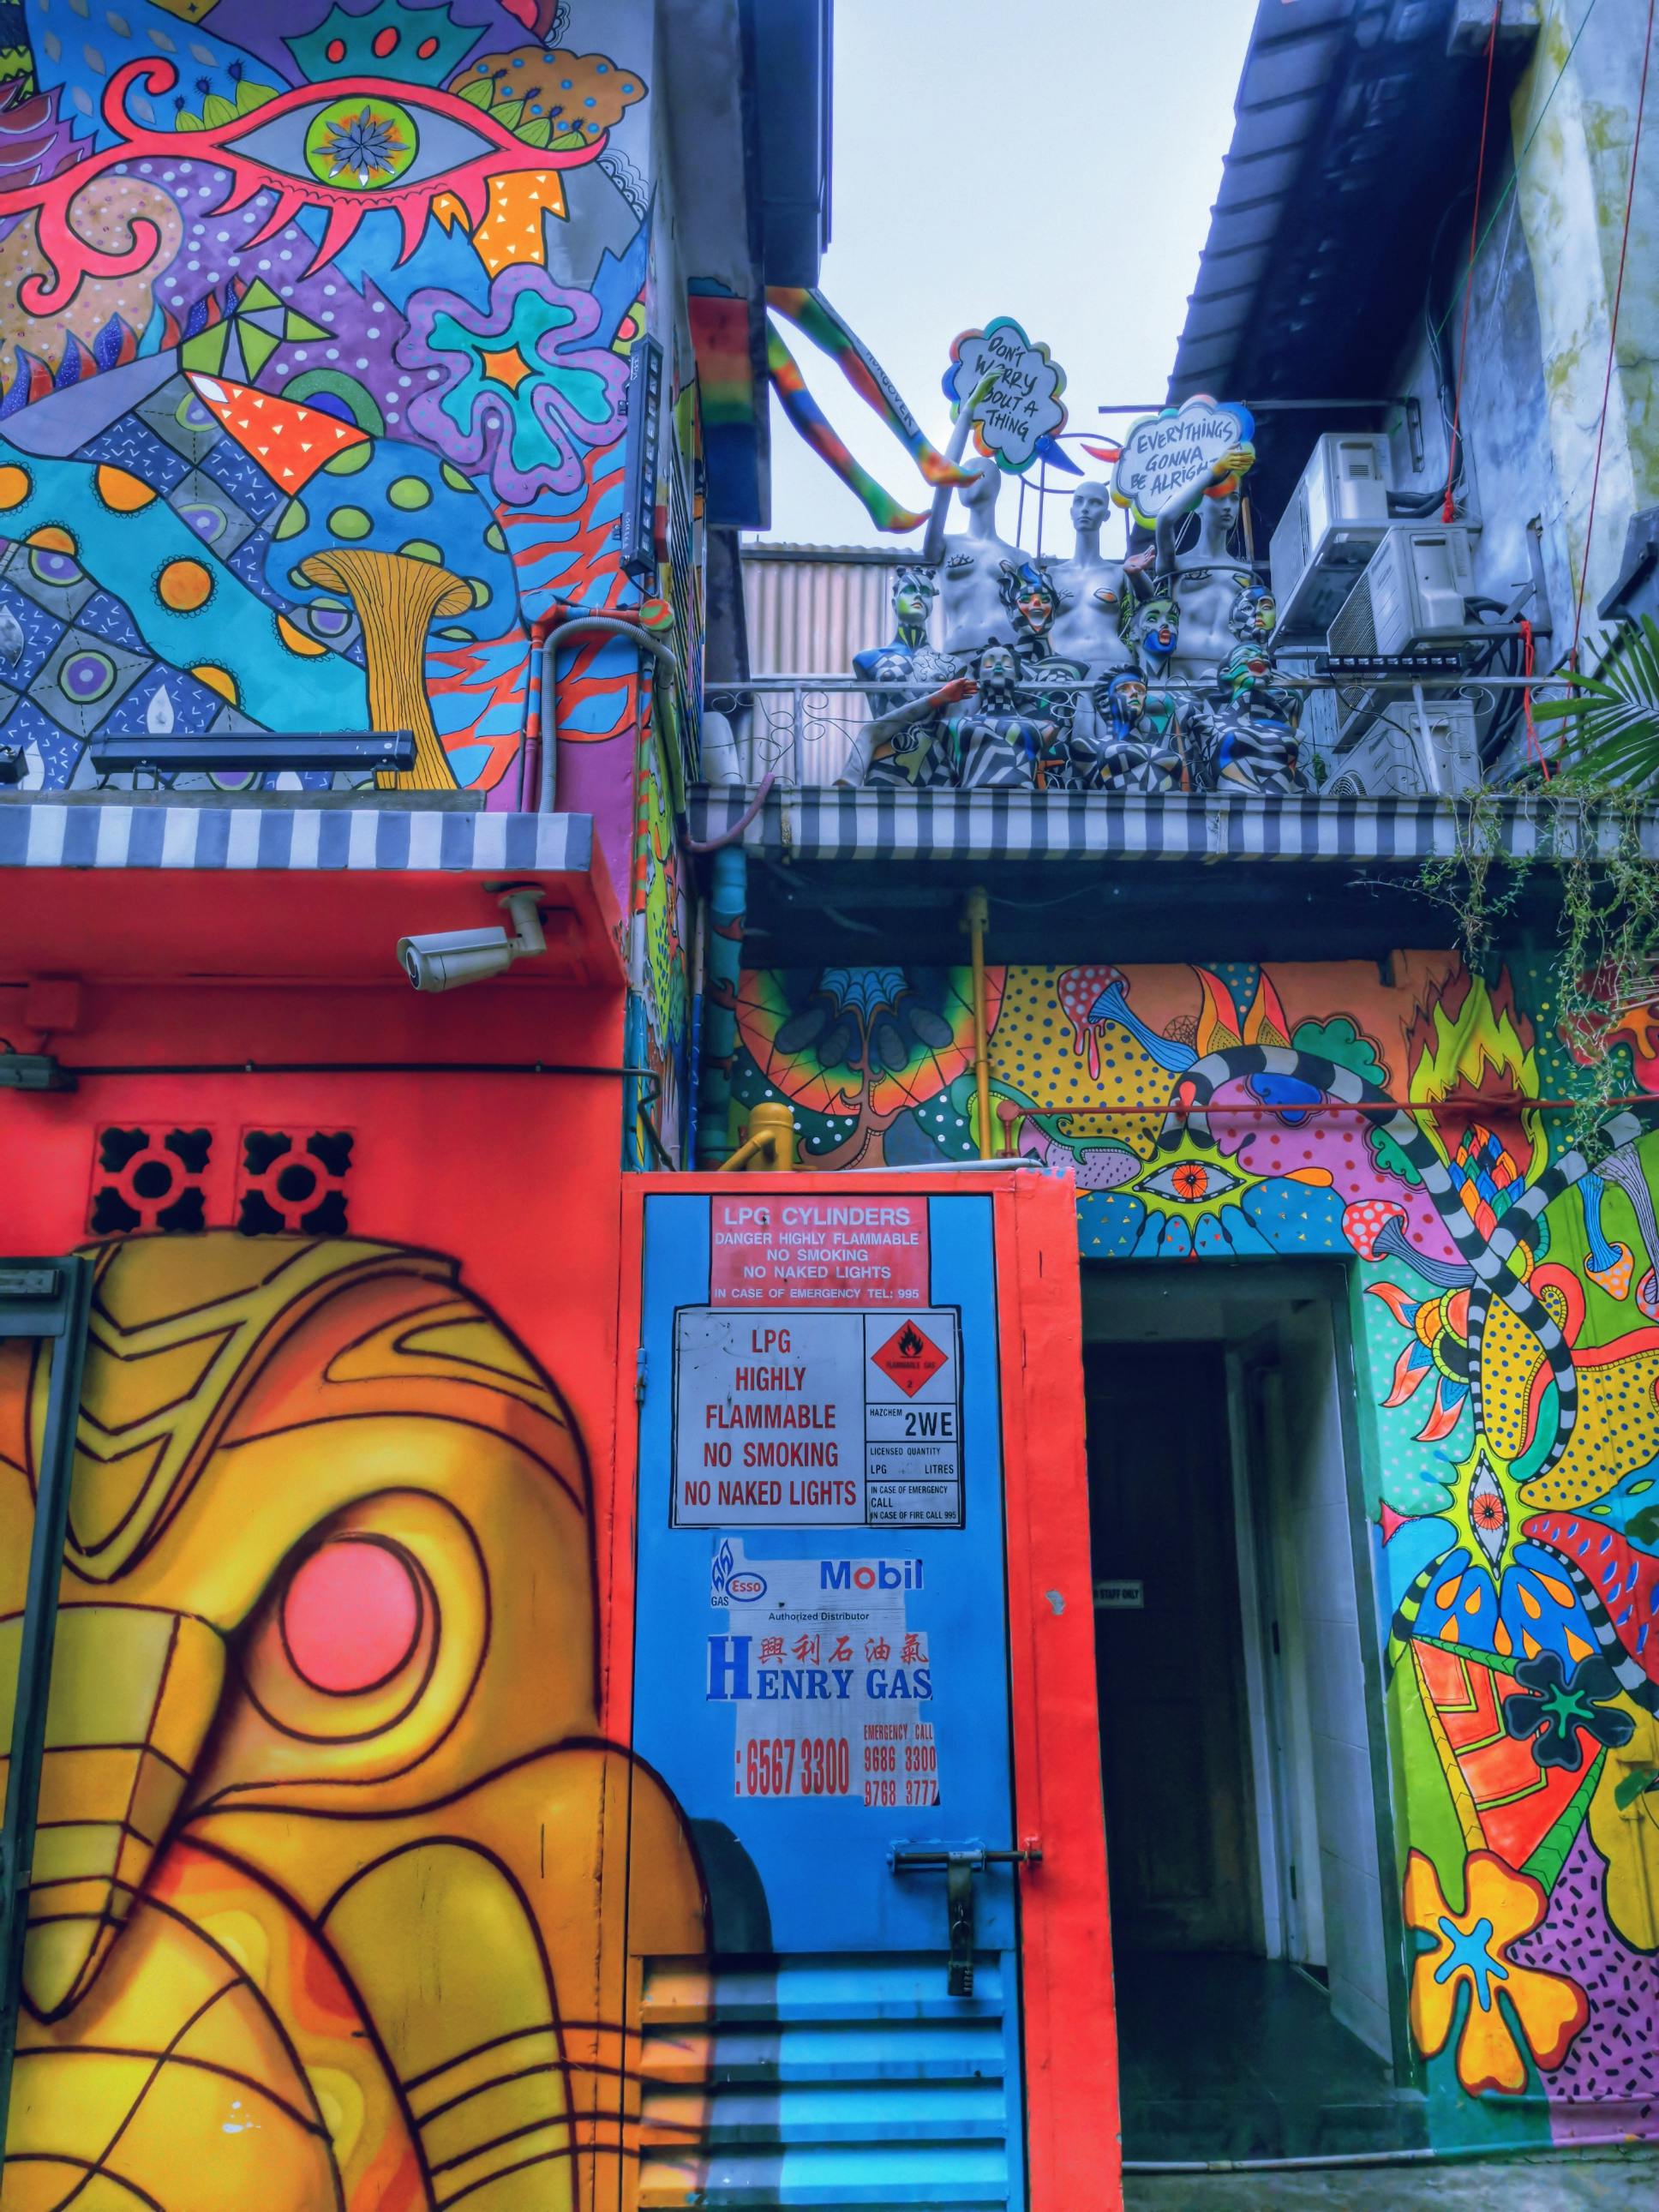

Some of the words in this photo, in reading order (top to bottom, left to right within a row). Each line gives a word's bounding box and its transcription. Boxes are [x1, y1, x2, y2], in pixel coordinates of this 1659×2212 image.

[988, 337, 1026, 367] DON'T
[1024, 400, 1039, 417] A
[985, 409, 1029, 442] THING
[1137, 418, 1234, 454] EVERYTHINGS
[1145, 446, 1203, 472] GONNA
[1130, 472, 1147, 490] BE
[724, 1207, 770, 1226] LPG
[782, 1207, 910, 1226] CYLINDERS
[715, 1232, 772, 1245] DANGER
[779, 1232, 826, 1245] HIGHLY
[834, 1232, 919, 1245] FLAMMABLE
[767, 1249, 790, 1262] NO
[797, 1249, 868, 1262] SMOKING
[743, 1266, 766, 1279] NO
[774, 1266, 829, 1279] NAKED
[835, 1266, 892, 1279] LIGHTS
[714, 1288, 727, 1298] IN
[731, 1288, 763, 1299] CASE
[768, 1288, 784, 1299] OF
[789, 1288, 861, 1299] EMERGENCY
[867, 1288, 894, 1299] TEL:
[897, 1288, 919, 1299] 995
[752, 1329, 792, 1353] LPG
[734, 1366, 807, 1391] HIGHLY
[906, 1380, 913, 1388] 2
[705, 1404, 837, 1430] FLAMMABLE
[870, 1408, 903, 1417] HAZCHEM
[904, 1412, 953, 1436] 2WE
[703, 1442, 732, 1468] NO
[743, 1442, 839, 1468] SMOKING
[870, 1447, 904, 1456] LICENSED
[907, 1447, 941, 1456] QUANTITY
[871, 1464, 888, 1475] LPG
[925, 1464, 955, 1475] LITRES
[685, 1480, 710, 1506] NO
[718, 1480, 782, 1506] NAKED
[789, 1480, 857, 1506] LIGHTS
[871, 1485, 878, 1494] IN
[879, 1485, 897, 1494] CASE
[897, 1485, 907, 1494] OF
[908, 1485, 948, 1494] EMERGENCY
[871, 1497, 894, 1508] CALL
[870, 1511, 879, 1520] IN
[879, 1511, 898, 1520] CASE
[899, 1511, 908, 1520] OF
[909, 1511, 925, 1520] FIRE
[925, 1511, 943, 1520] CALL
[943, 1511, 957, 1520] 995
[820, 1561, 923, 1590] Mobil
[732, 1580, 762, 1592] Esso
[711, 1596, 729, 1607] GAS
[769, 1612, 818, 1622] Authorized
[820, 1611, 870, 1622] Distributor
[757, 1634, 930, 1666] 興利石油氣
[706, 1635, 854, 1700] HENRY
[865, 1669, 932, 1700] GAS
[864, 1724, 908, 1741] EMERGENCY
[915, 1725, 933, 1741] CALL
[746, 1738, 796, 1795] 6567
[800, 1737, 850, 1795] 3300
[864, 1746, 896, 1771] 9686
[905, 1746, 937, 1771] 3300
[864, 1780, 896, 1807] 9768
[906, 1780, 937, 1807] 3777
